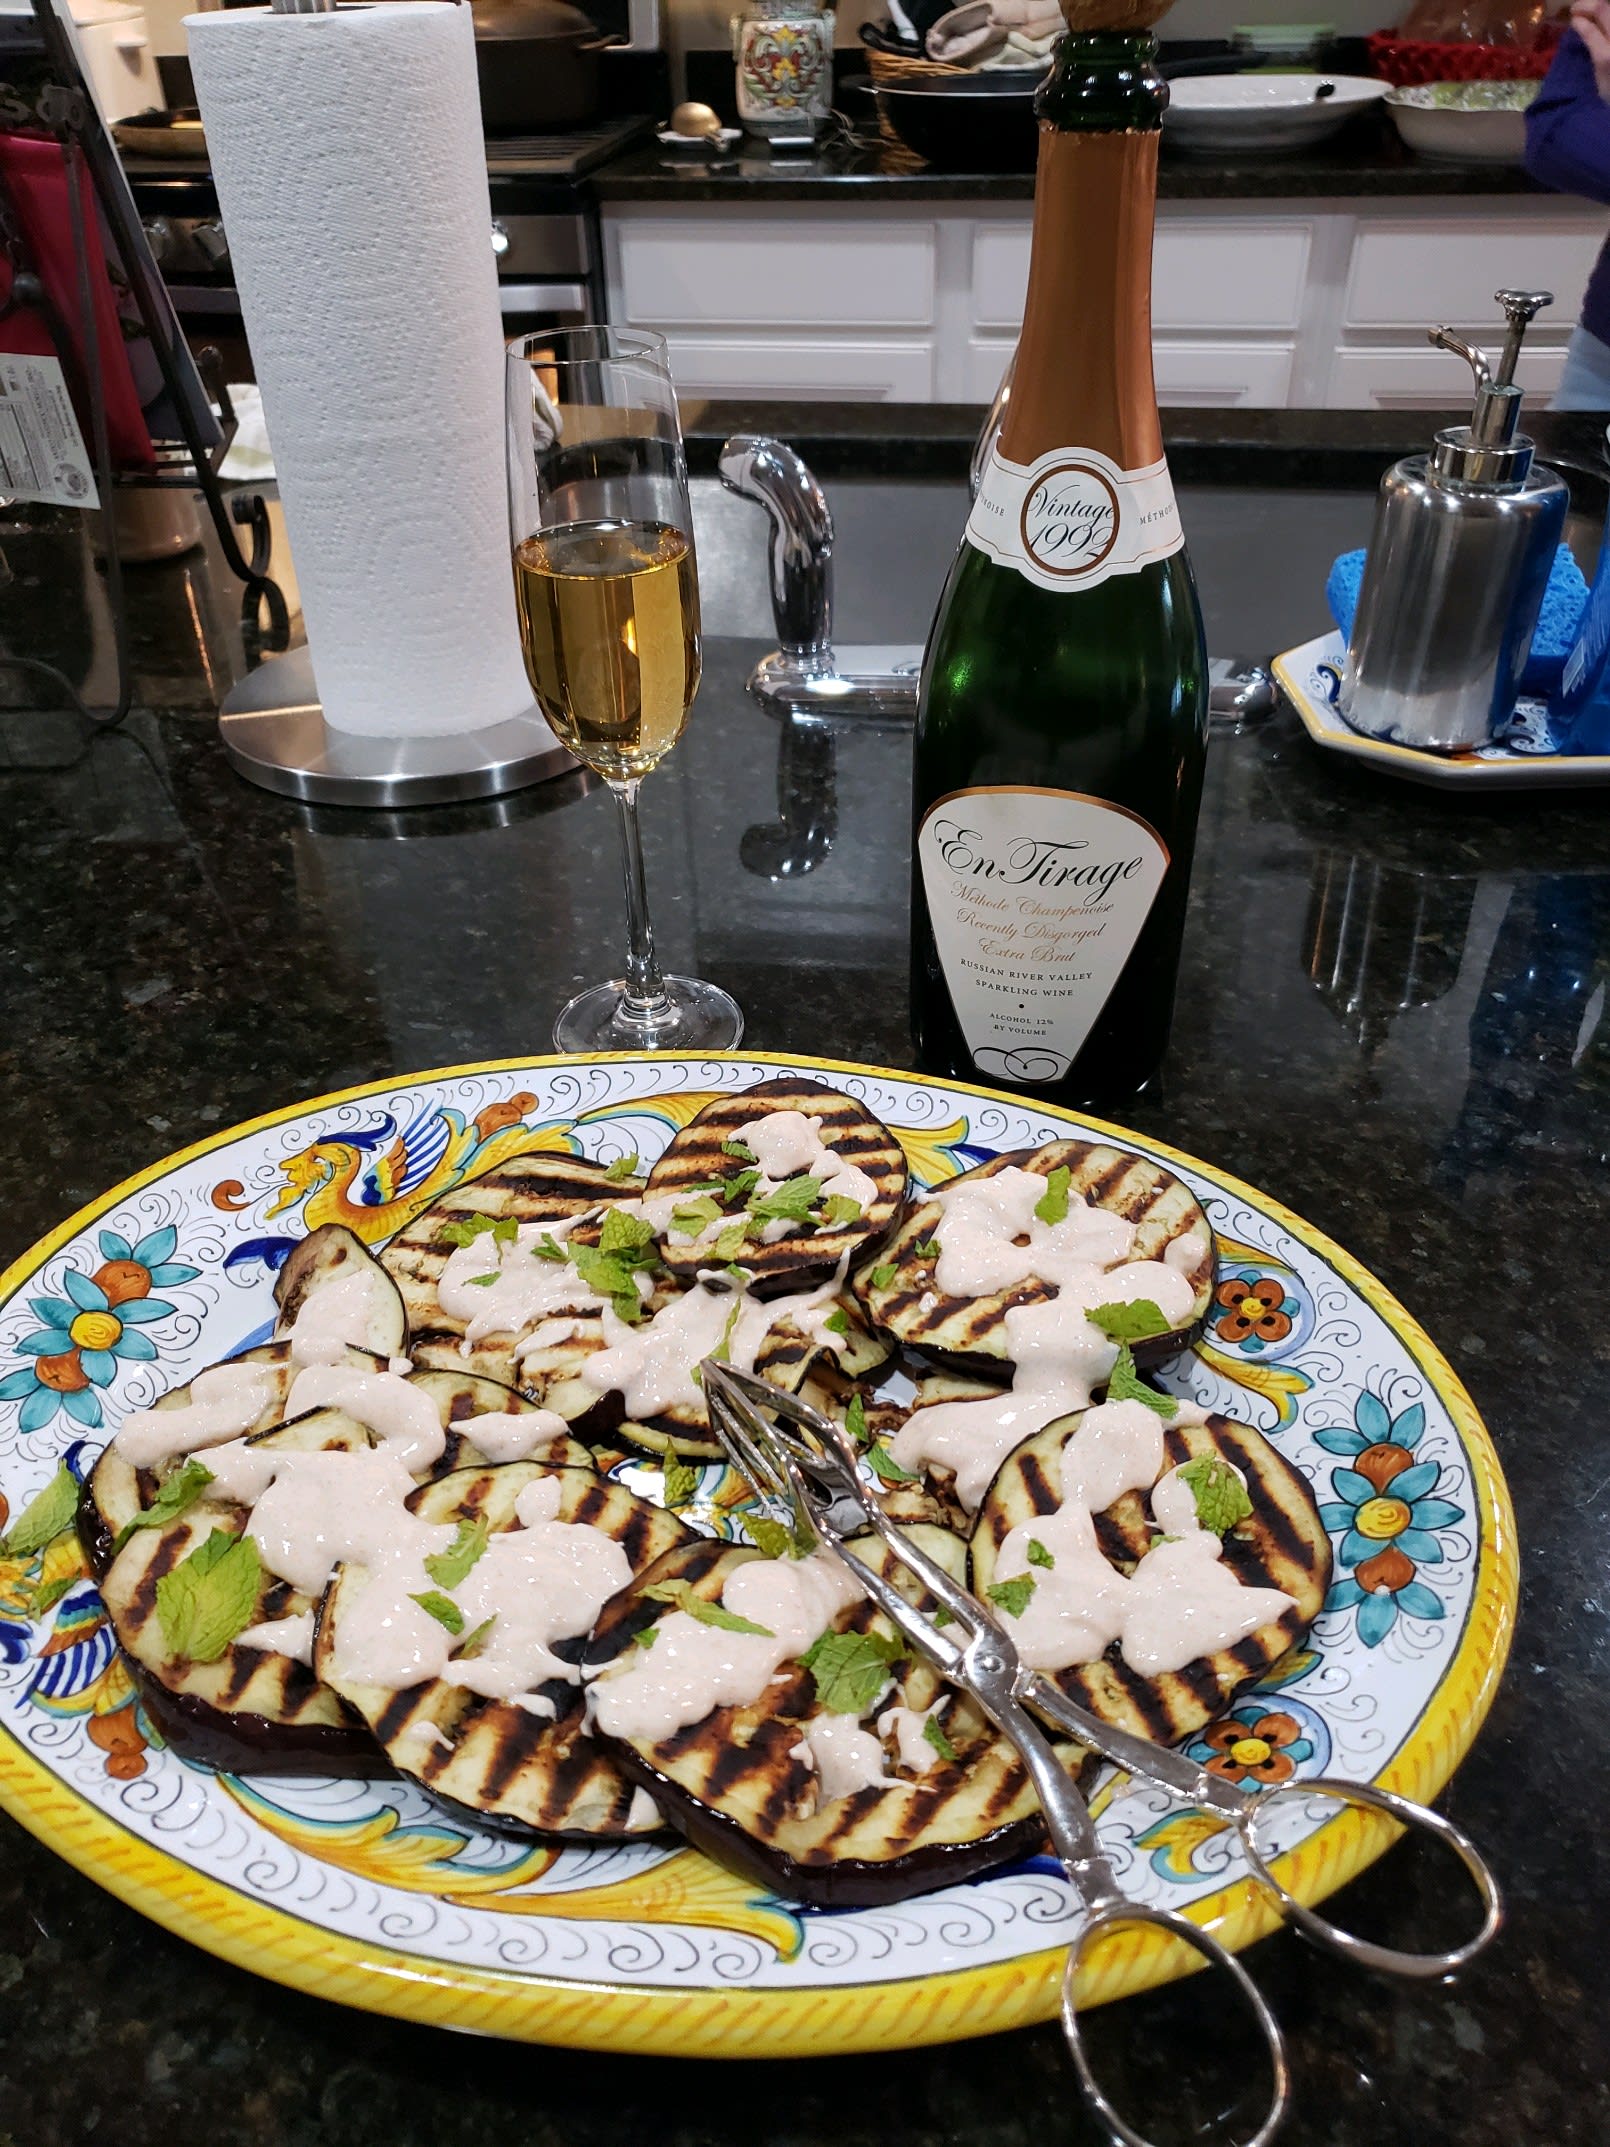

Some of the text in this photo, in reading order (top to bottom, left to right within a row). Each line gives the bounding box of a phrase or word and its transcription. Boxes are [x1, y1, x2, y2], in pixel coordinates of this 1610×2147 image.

[1028, 484, 1114, 530] Vintage
[1030, 523, 1113, 558] 1992
[934, 820, 1143, 907] En Tirage
[950, 880, 1114, 922] Methode Champenoise
[956, 907, 1107, 945] Recently Disgorged
[978, 937, 1077, 962] Extra Brut
[960, 958, 1093, 981] RUSSIAN RIVER VALLEY
[975, 979, 1074, 997] SPARKLING WINE
[989, 1012, 1032, 1024] ALCOHOL
[993, 1024, 1047, 1036] BY VOLUME
